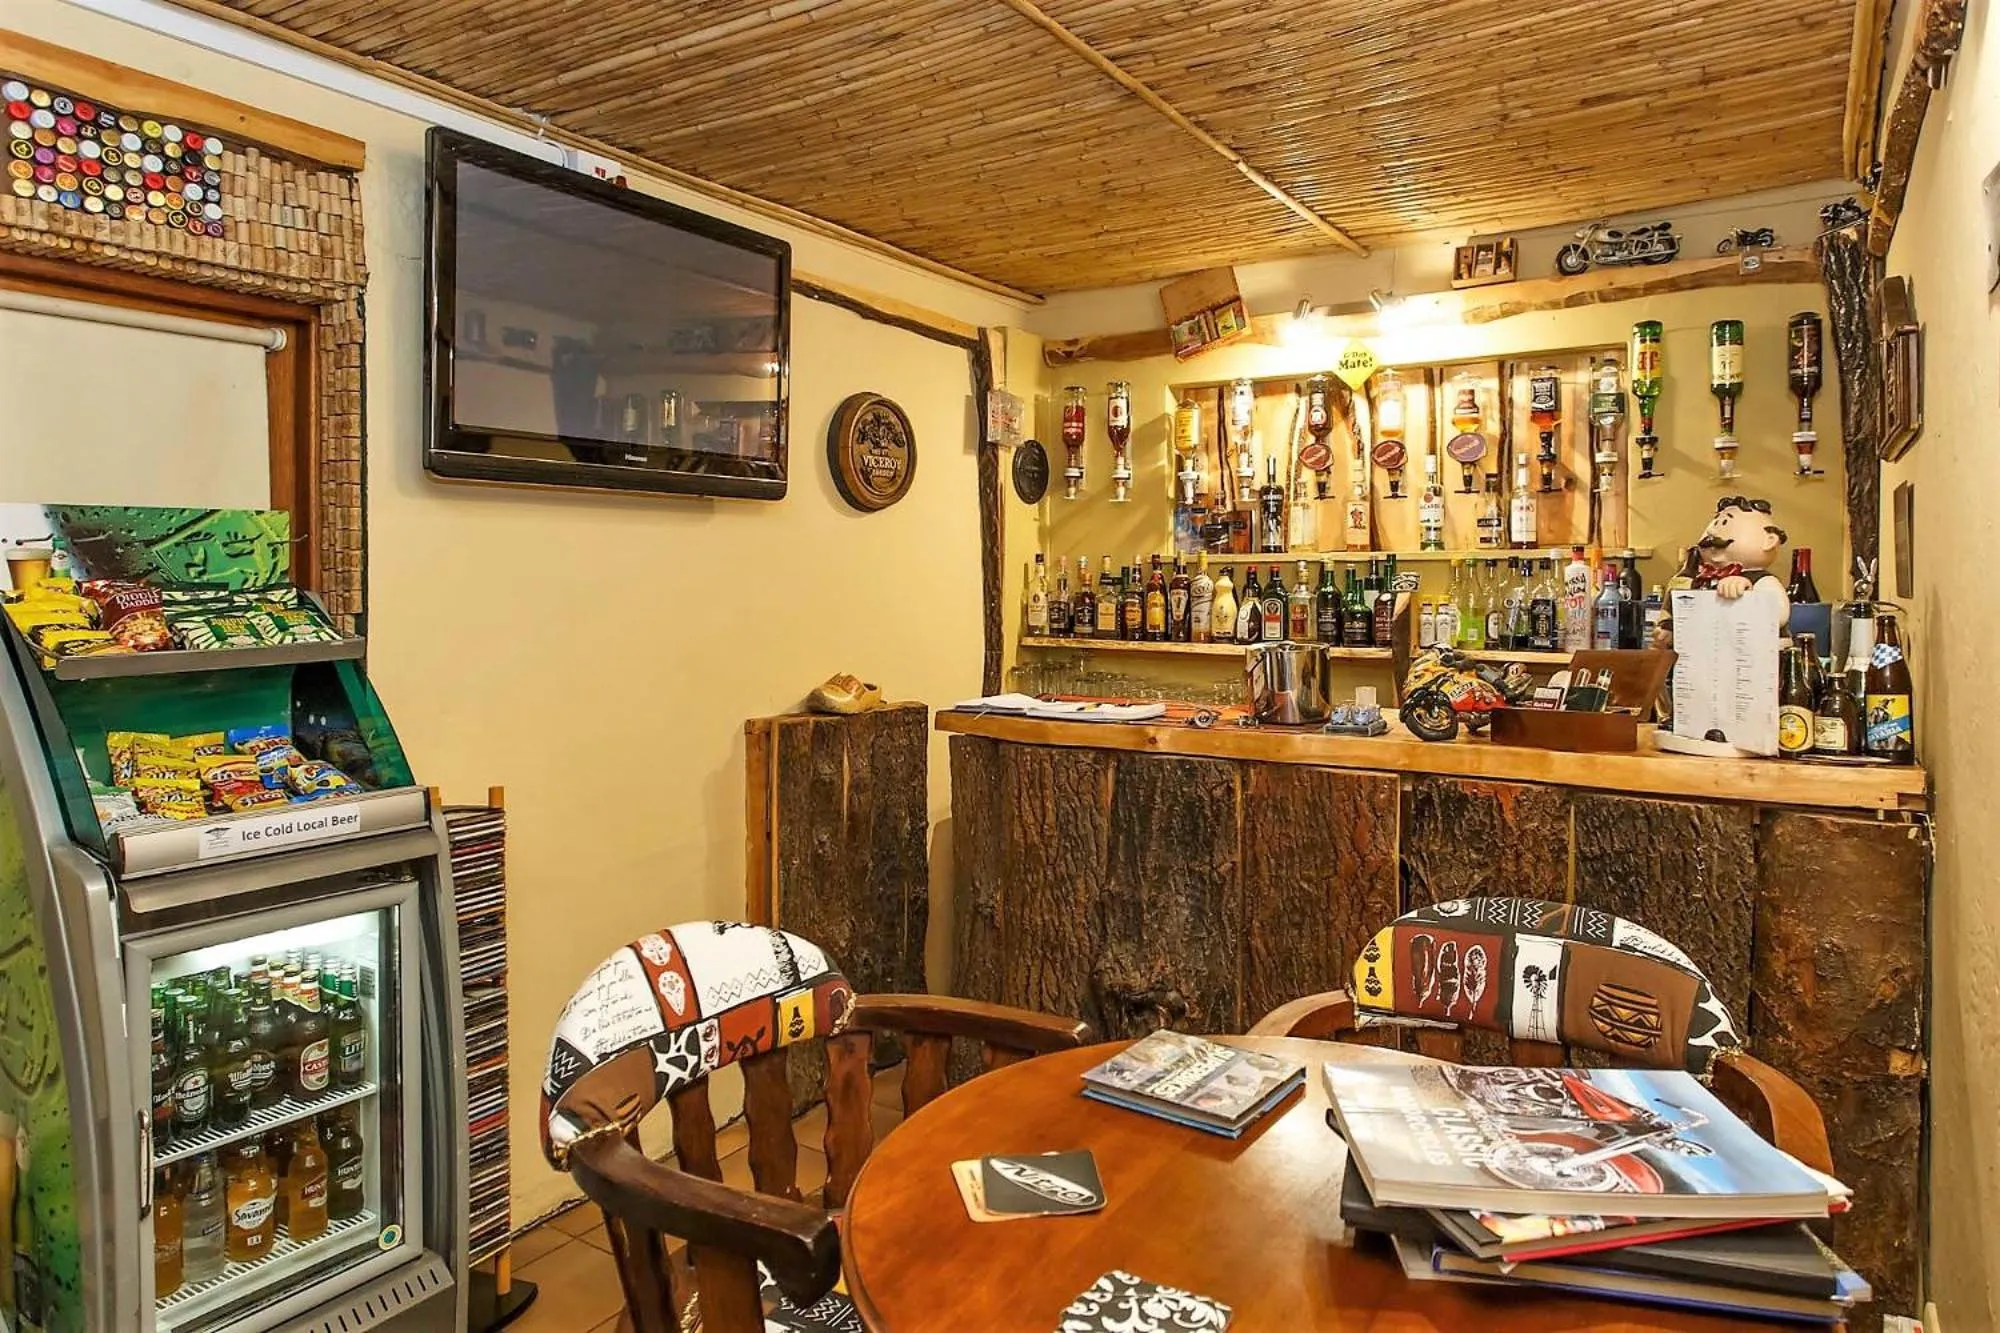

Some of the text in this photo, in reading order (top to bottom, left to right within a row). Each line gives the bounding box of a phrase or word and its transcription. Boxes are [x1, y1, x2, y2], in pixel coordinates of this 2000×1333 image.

[1338, 356, 1373, 370] Mate!
[242, 813, 359, 841] Ice Cold Local Beer
[1430, 1107, 1487, 1169] CLASSIC
[1002, 1163, 1085, 1203] Nitro
